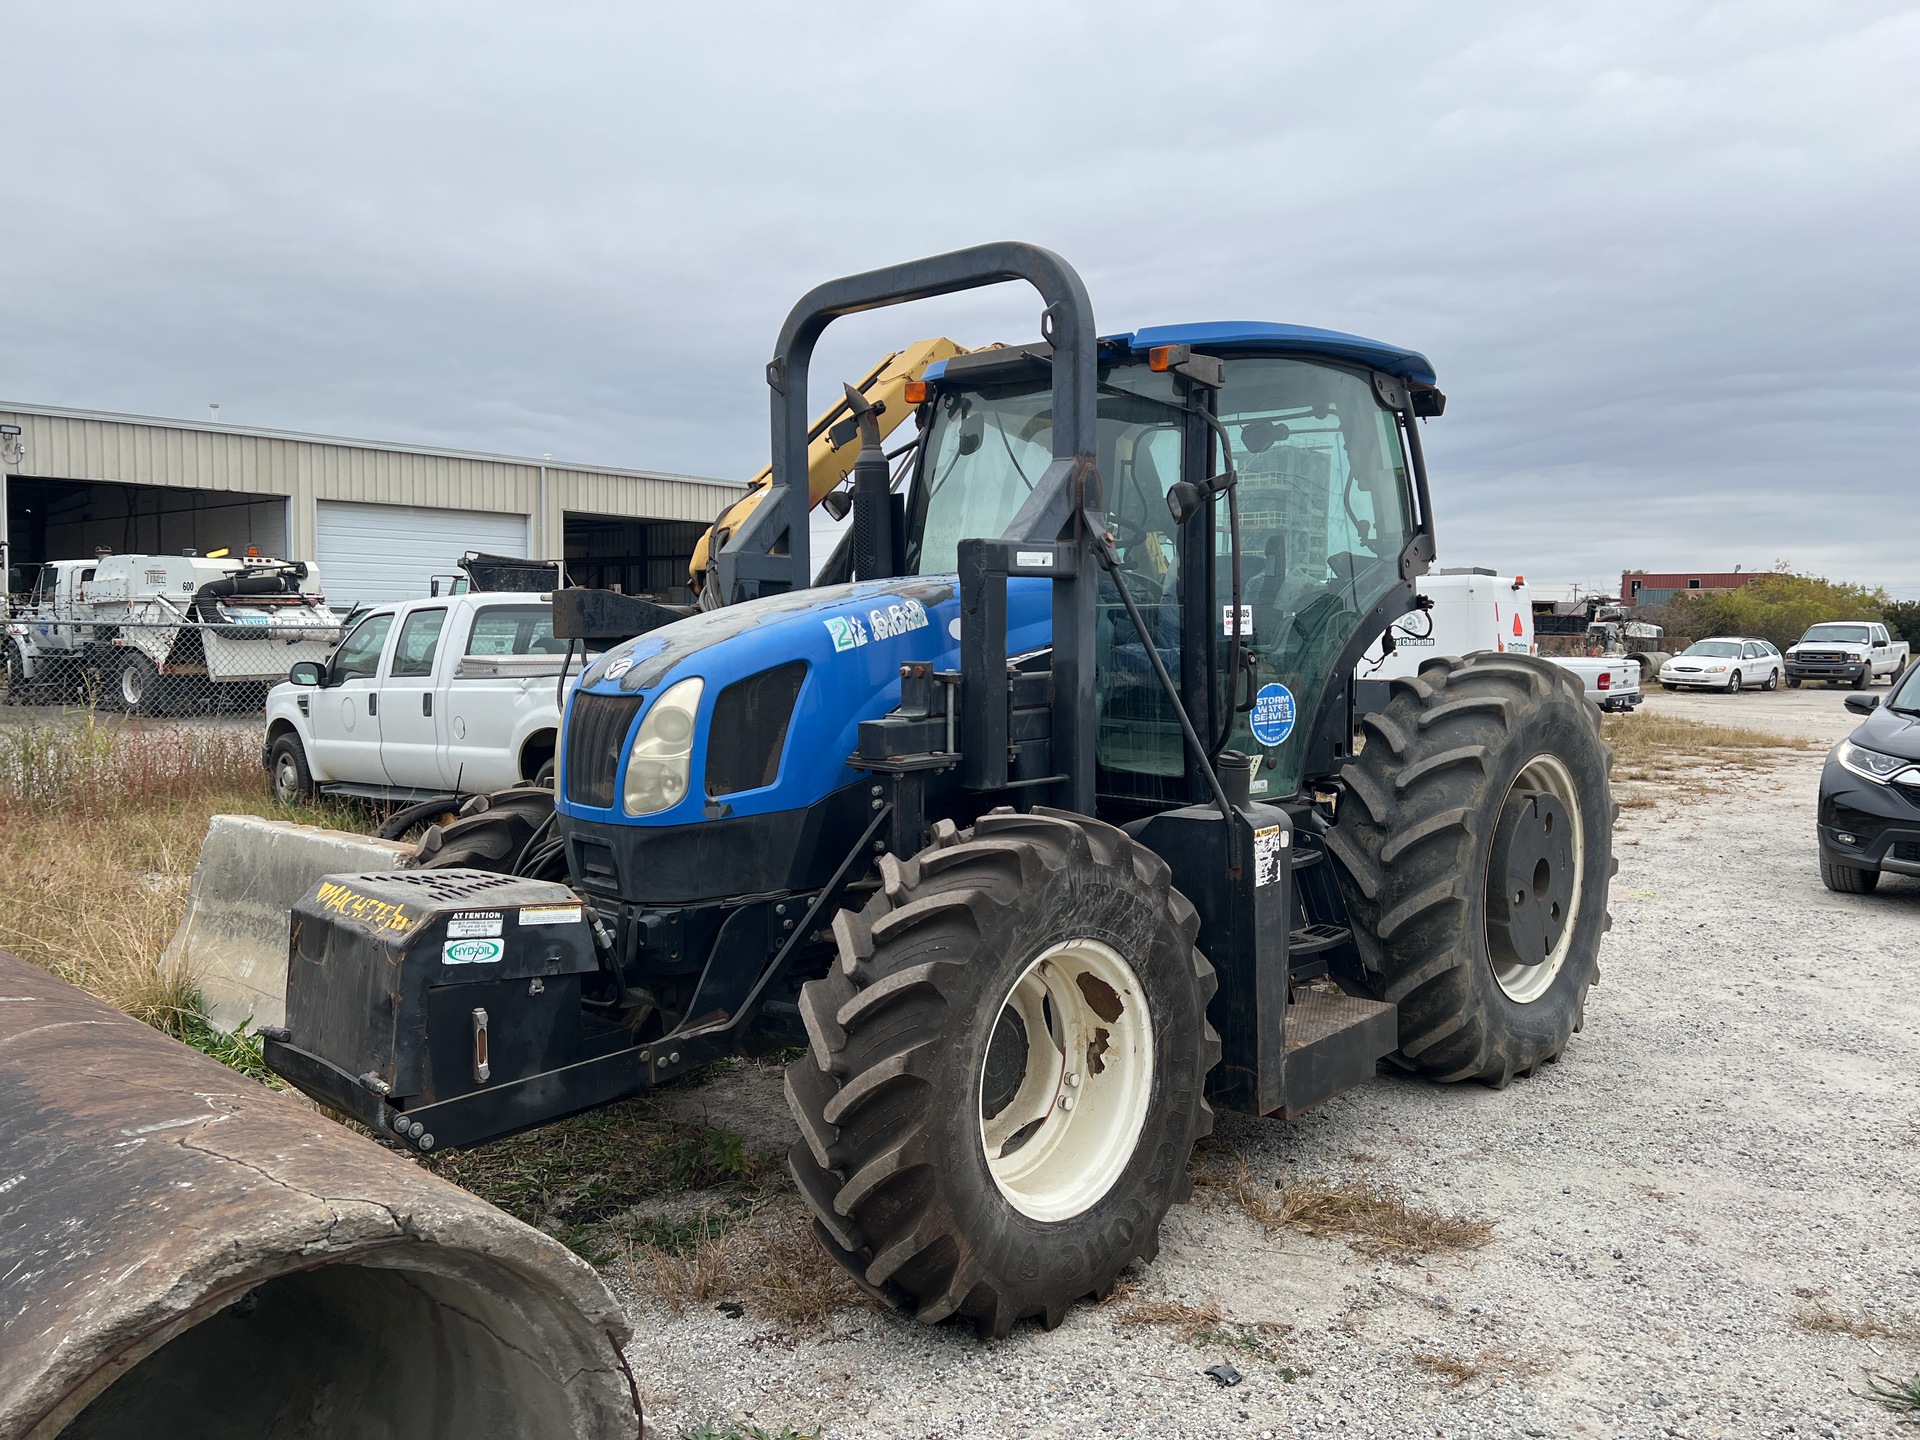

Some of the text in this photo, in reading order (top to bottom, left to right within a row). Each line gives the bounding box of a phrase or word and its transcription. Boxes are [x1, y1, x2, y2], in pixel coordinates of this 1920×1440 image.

[183, 581, 195, 592] 600
[1402, 637, 1434, 647] Charleston
[1256, 695, 1290, 706] STORM
[1257, 703, 1290, 714] WATER
[1253, 711, 1293, 722] SERVICE
[1260, 826, 1278, 836] WARNING
